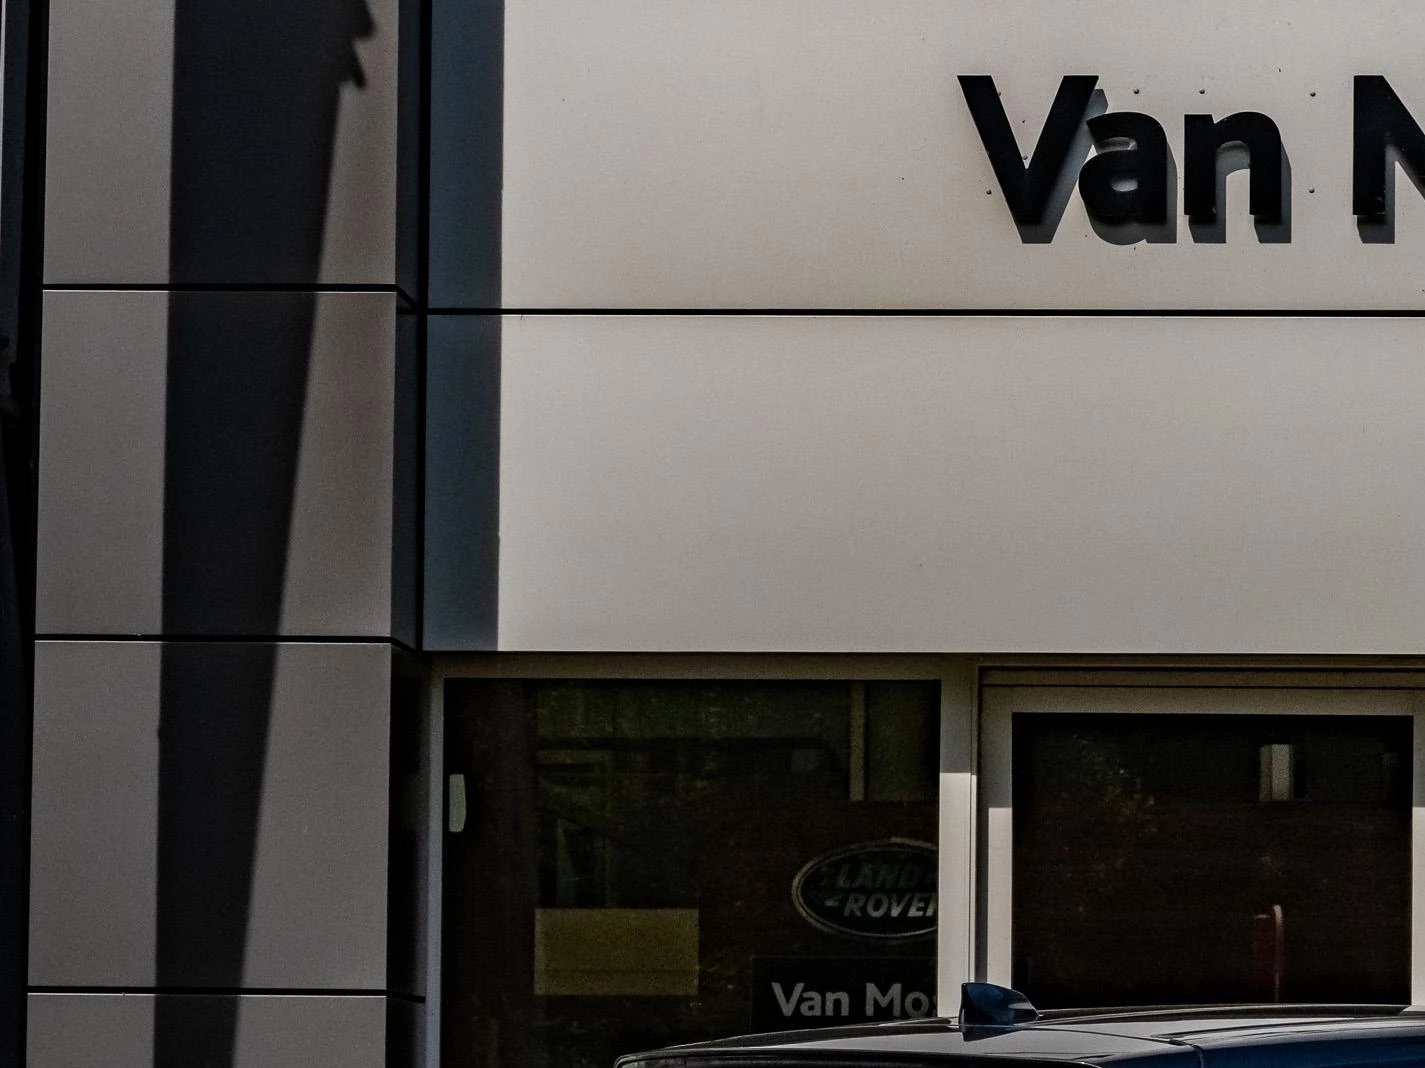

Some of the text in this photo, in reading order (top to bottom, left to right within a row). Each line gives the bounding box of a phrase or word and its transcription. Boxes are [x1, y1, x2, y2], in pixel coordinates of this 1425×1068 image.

[956, 74, 1282, 225] Van
[836, 862, 922, 889] LAND
[771, 982, 938, 1018] Van Mo
